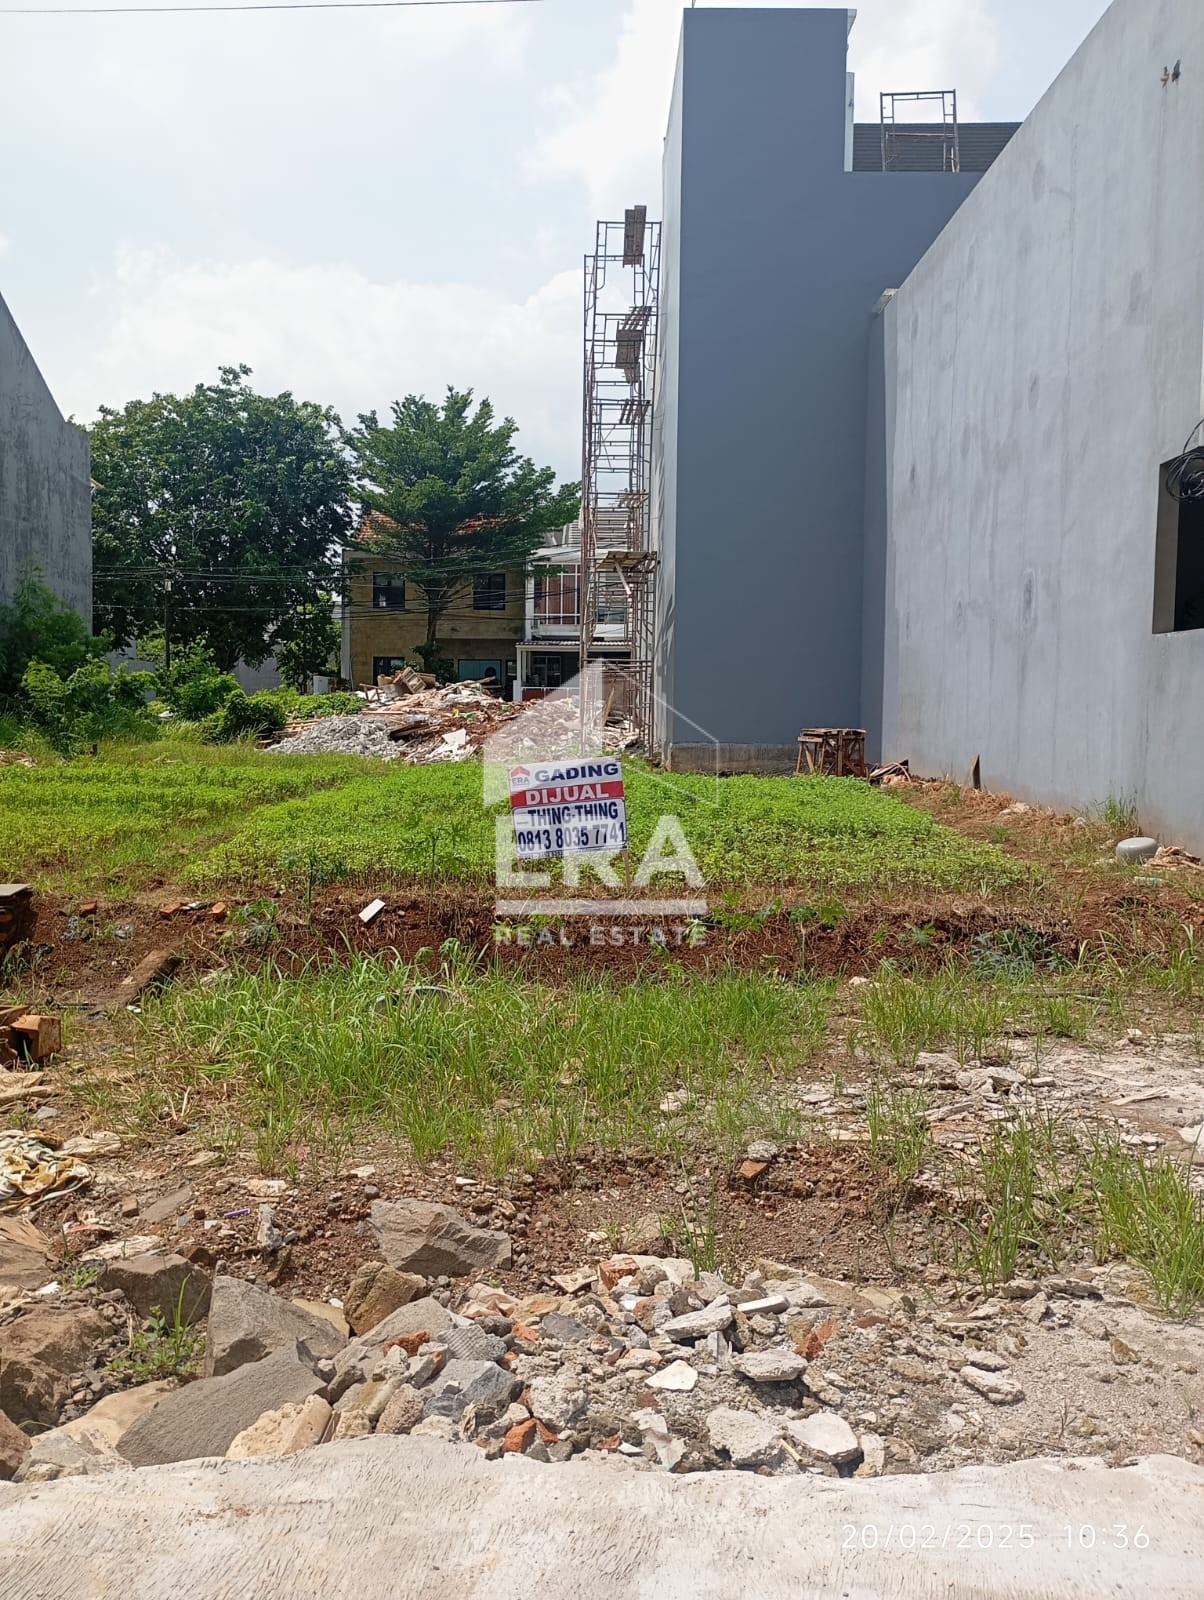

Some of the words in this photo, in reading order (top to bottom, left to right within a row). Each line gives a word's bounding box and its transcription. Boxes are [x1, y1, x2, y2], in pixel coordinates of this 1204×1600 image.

[511, 777, 530, 785] ERA
[534, 763, 619, 782] GADING
[525, 783, 609, 805] DIJUAL
[527, 801, 618, 827] THING-THING
[518, 829, 551, 852] 0813
[555, 826, 589, 848] 8035
[592, 822, 625, 845] 7741
